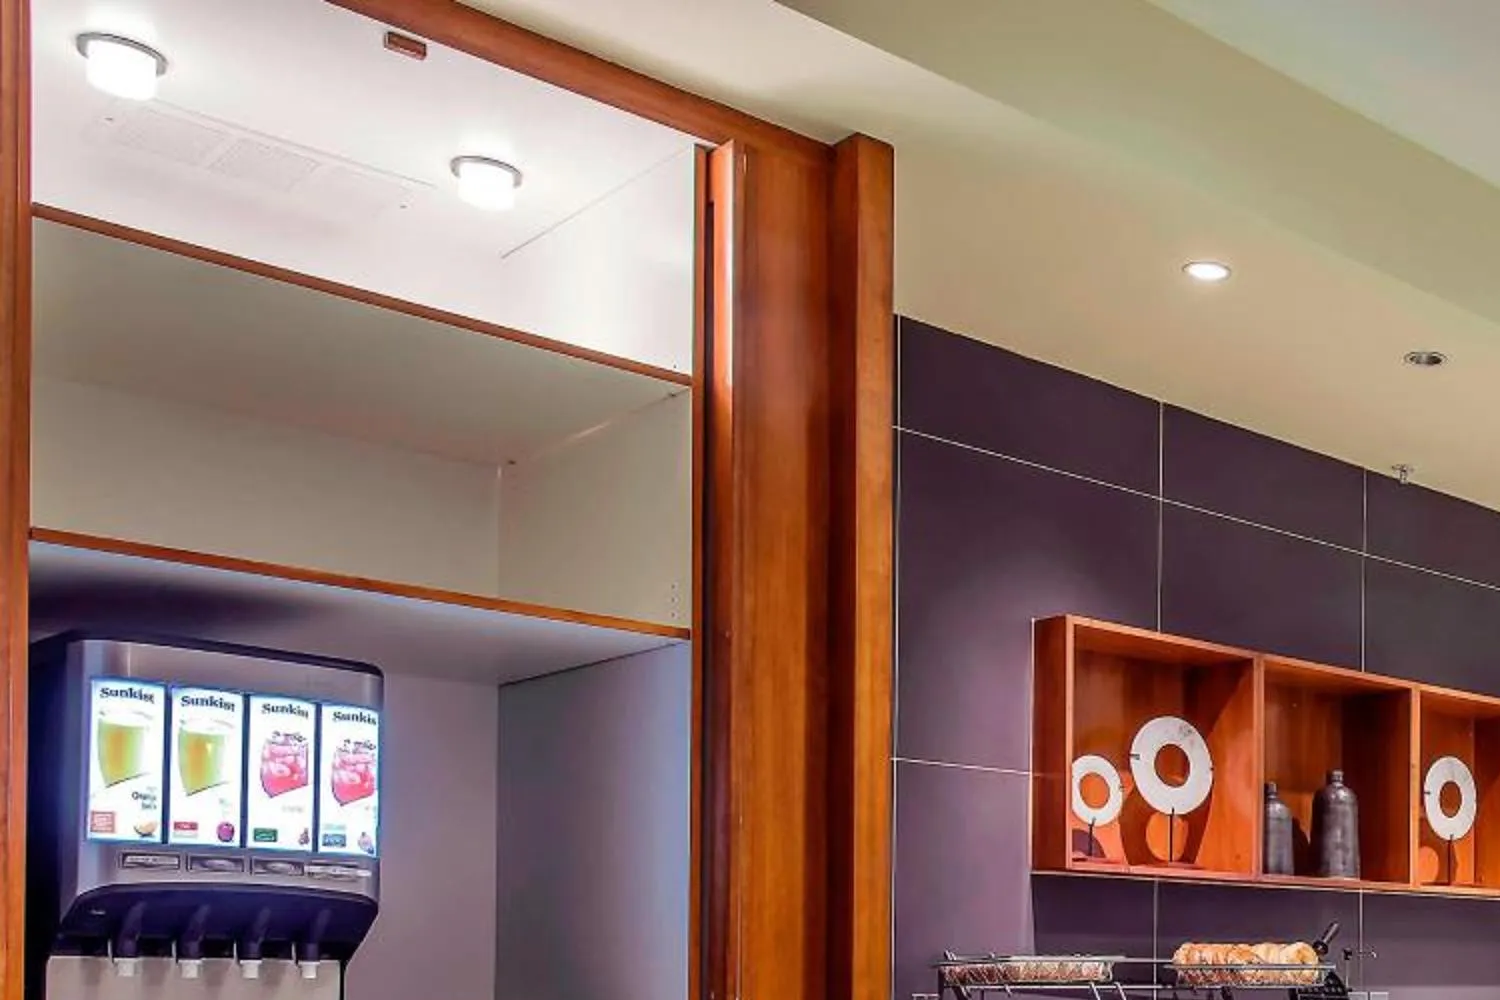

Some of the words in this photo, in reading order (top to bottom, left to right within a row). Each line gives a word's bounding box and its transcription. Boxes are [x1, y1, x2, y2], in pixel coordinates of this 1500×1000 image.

[99, 687, 155, 704] Sunkist
[180, 695, 236, 712] Sunkist
[332, 711, 377, 725] Sunkis
